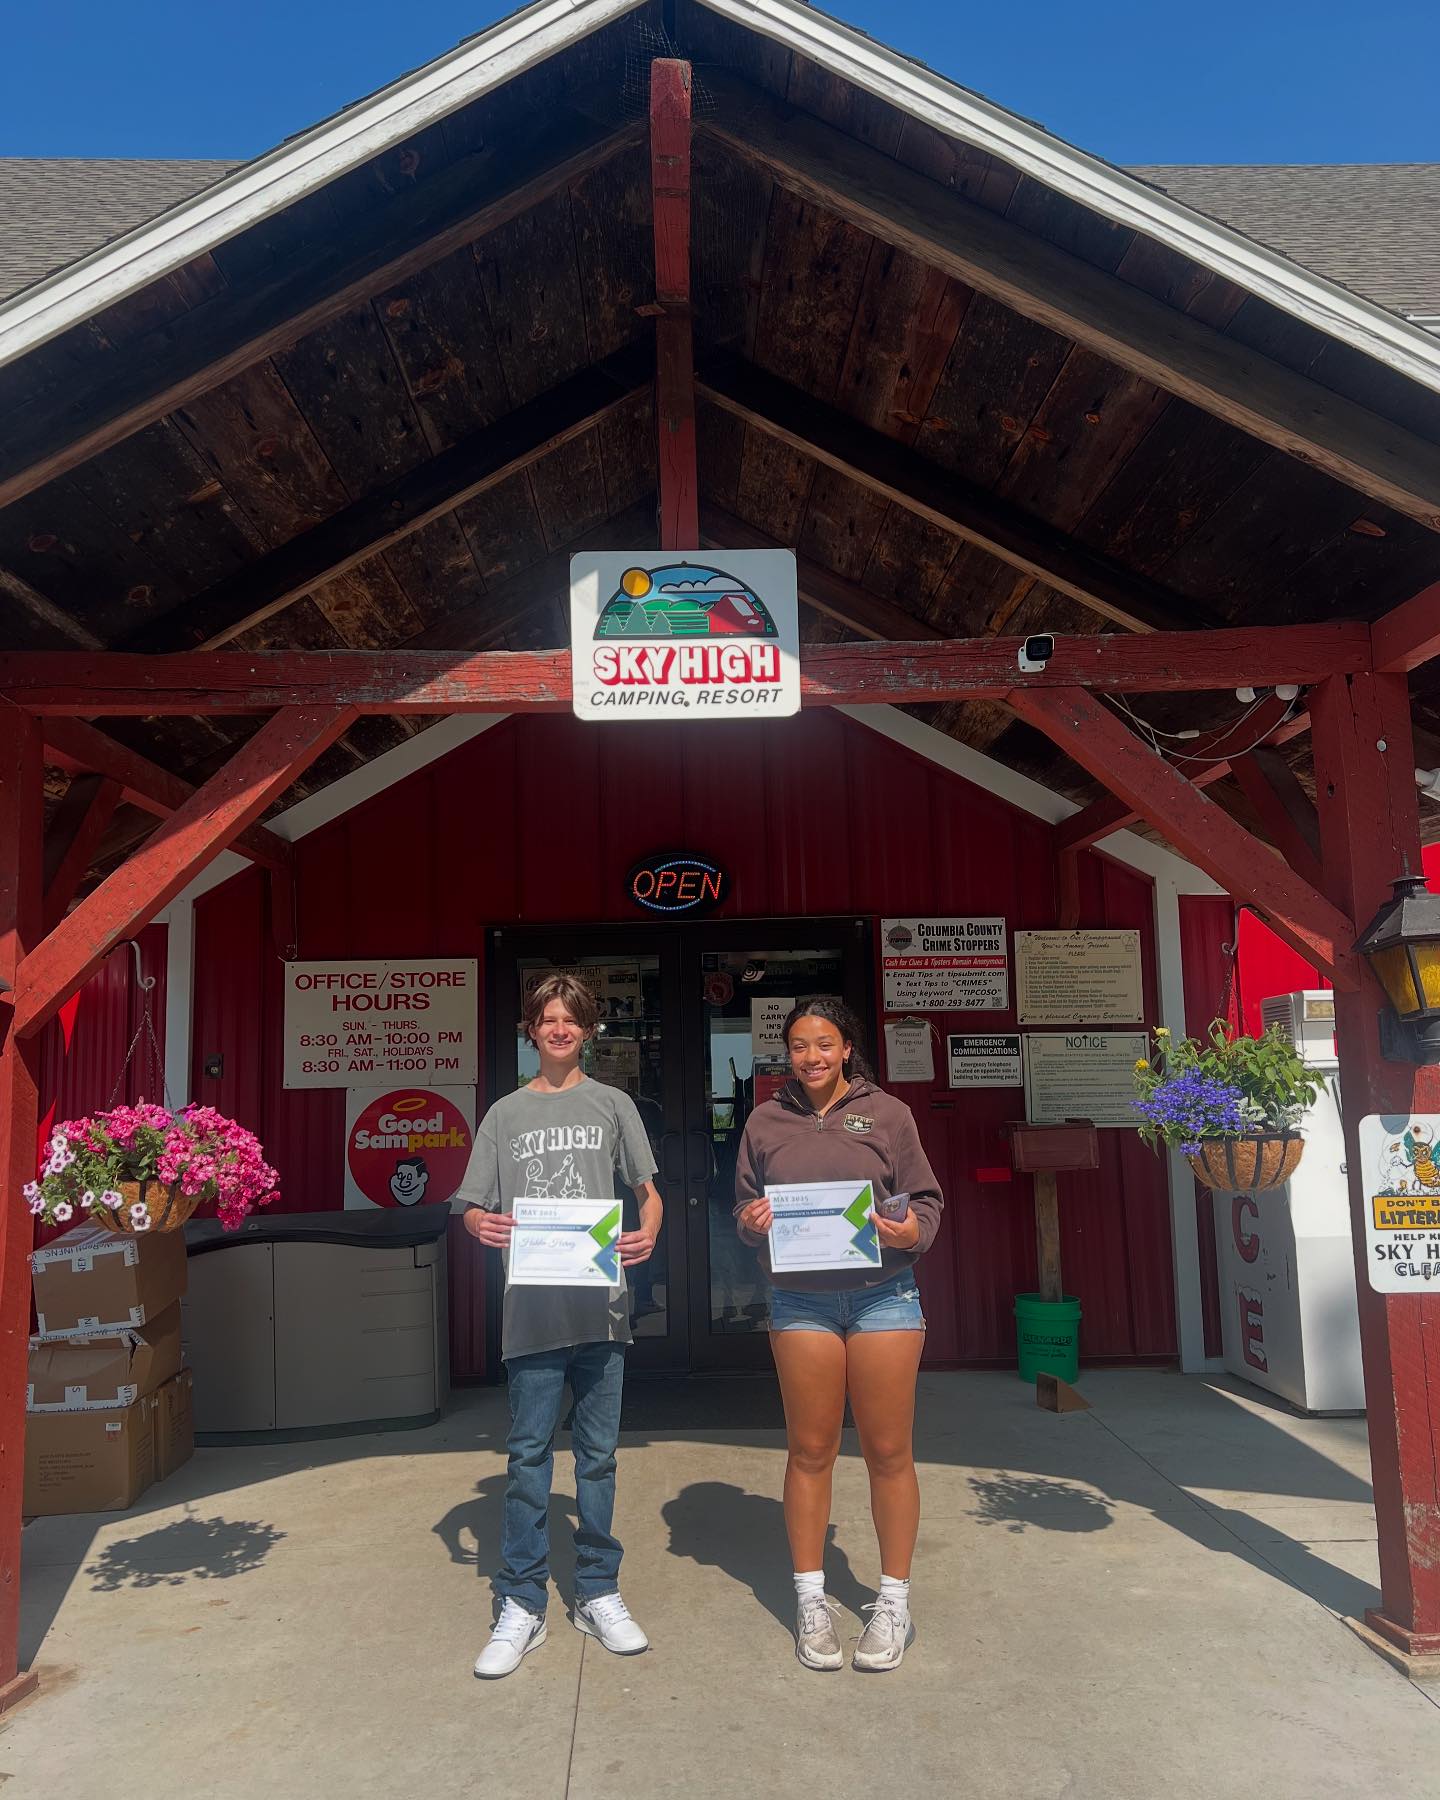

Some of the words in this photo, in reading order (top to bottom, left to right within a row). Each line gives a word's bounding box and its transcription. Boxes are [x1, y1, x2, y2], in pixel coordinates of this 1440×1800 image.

[593, 646, 677, 686] SKY
[680, 645, 781, 685] HIGH
[590, 690, 686, 706] CAMPING
[696, 689, 783, 705] RESORT
[633, 870, 722, 900] OPEN
[917, 923, 965, 937] COLUMBIA
[966, 922, 1003, 936] COUNTY
[922, 938, 952, 951] CRIME
[953, 937, 1000, 951] STOPPERS
[580, 966, 601, 977] High
[917, 970, 934, 979] Tips
[947, 970, 1005, 978] tipsubmit.com
[295, 971, 467, 991] OFFICE/STORE
[924, 980, 938, 988] Tips
[896, 990, 917, 998] Using
[920, 989, 954, 998] keyword
[332, 992, 430, 1012] HOURS
[760, 1013, 787, 1021] CARRY
[342, 1021, 367, 1032] SUN.
[382, 1020, 420, 1031] THURS.
[300, 1034, 338, 1047] 8:30
[438, 1031, 463, 1044] PM
[963, 1038, 1007, 1047] EMERGENCY
[1065, 1036, 1108, 1049] NOTICE
[383, 1046, 434, 1057] HOLIDAYS
[953, 1047, 1018, 1056] COMMUNICATIONS
[302, 1060, 340, 1073] 8:30
[434, 1057, 459, 1070] PM
[378, 1111, 443, 1134] Good
[355, 1127, 466, 1153] Sampark
[510, 1129, 546, 1162] SKY
[546, 1125, 603, 1151] HIGH
[1386, 1199, 1427, 1208] DON'T
[520, 1208, 538, 1217] MAY
[1380, 1209, 1440, 1226] LITTER
[1393, 1233, 1426, 1241] HELP
[1374, 1244, 1414, 1260] SKY
[1426, 1243, 1440, 1260] H
[1394, 1262, 1440, 1277] CLEA
